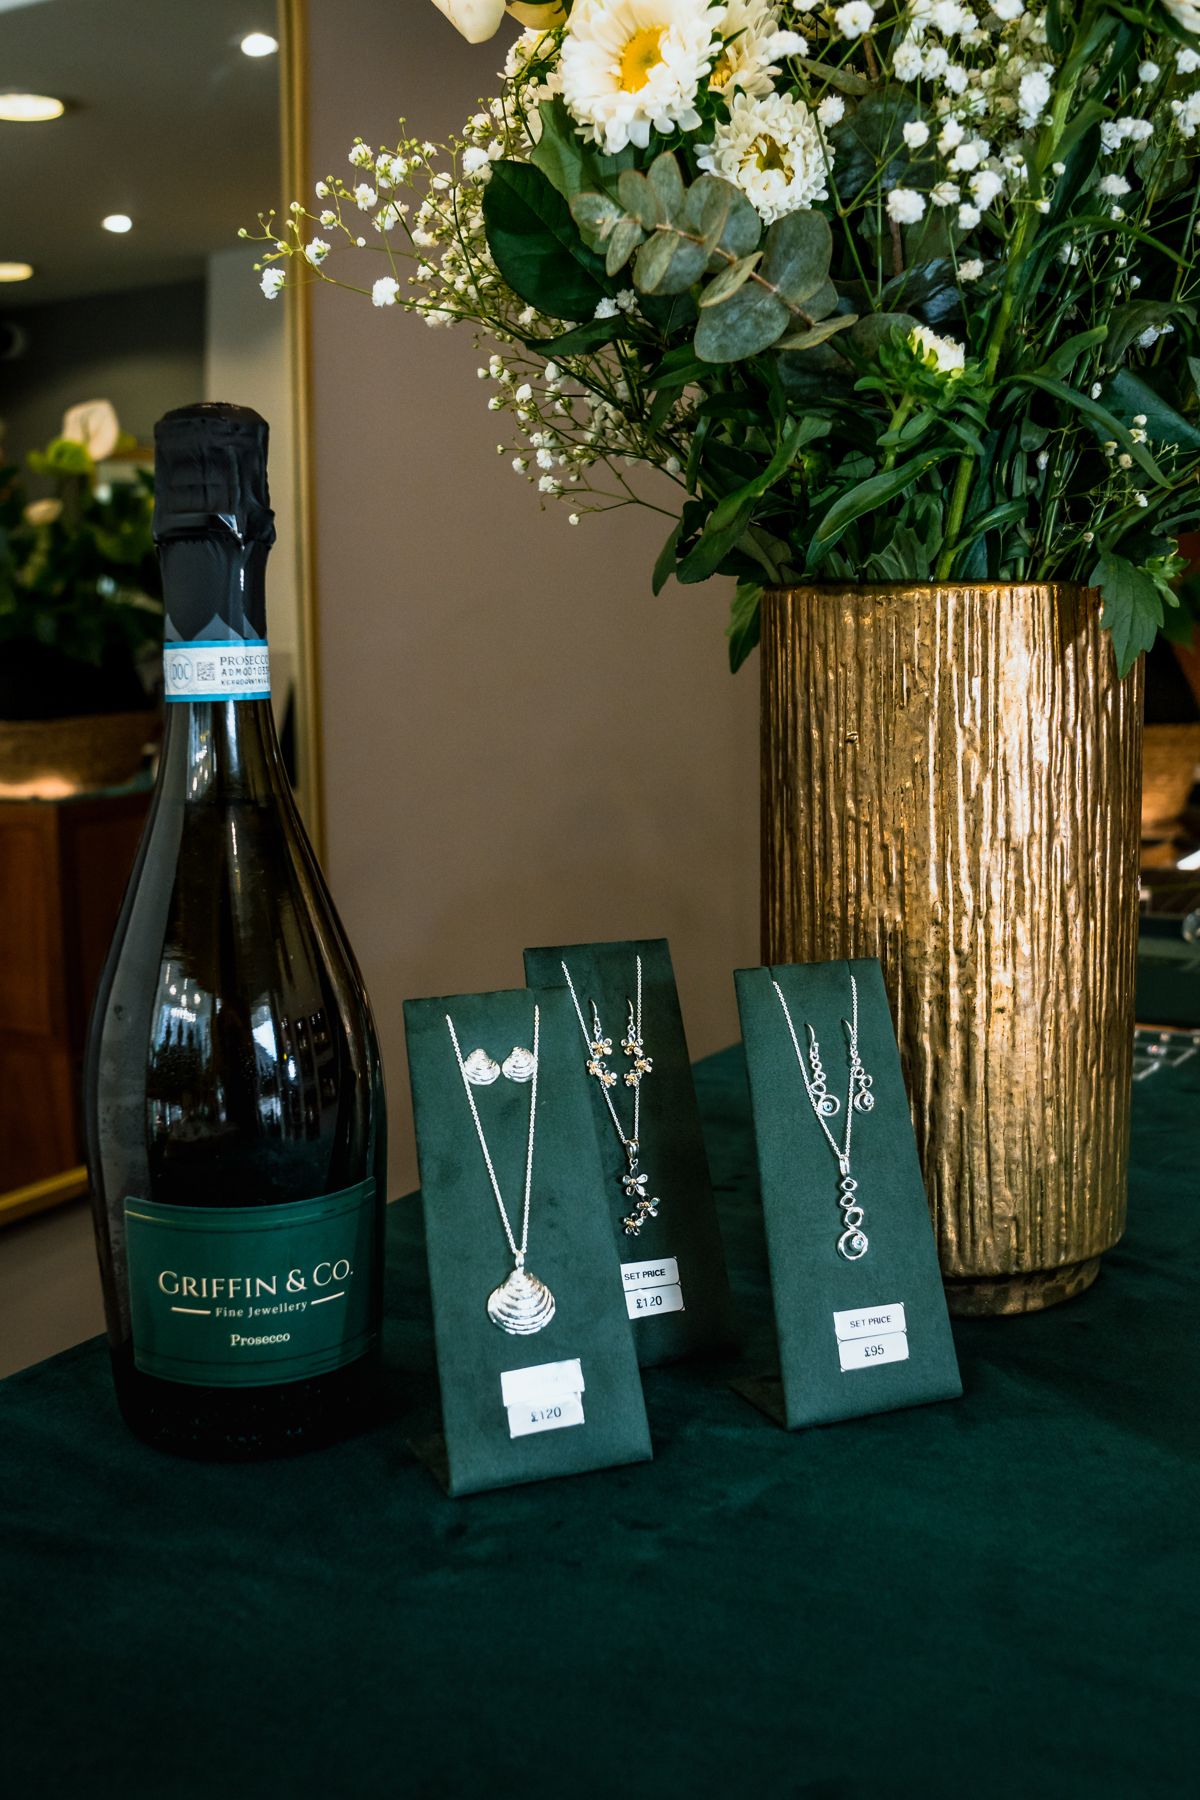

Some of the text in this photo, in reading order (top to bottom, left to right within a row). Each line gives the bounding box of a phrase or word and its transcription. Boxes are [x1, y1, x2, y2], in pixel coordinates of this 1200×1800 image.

[172, 663, 189, 680] DOC
[624, 1268, 667, 1281] SET PRICE
[158, 1270, 277, 1299] GRIFFIN
[286, 1268, 308, 1293] &
[636, 1295, 663, 1309] £120
[215, 1301, 308, 1318] Fine Jewellery
[849, 1315, 892, 1328] SET PRICE
[231, 1332, 290, 1346] Prosecco
[864, 1344, 885, 1357] £95
[530, 1406, 562, 1422] £120
